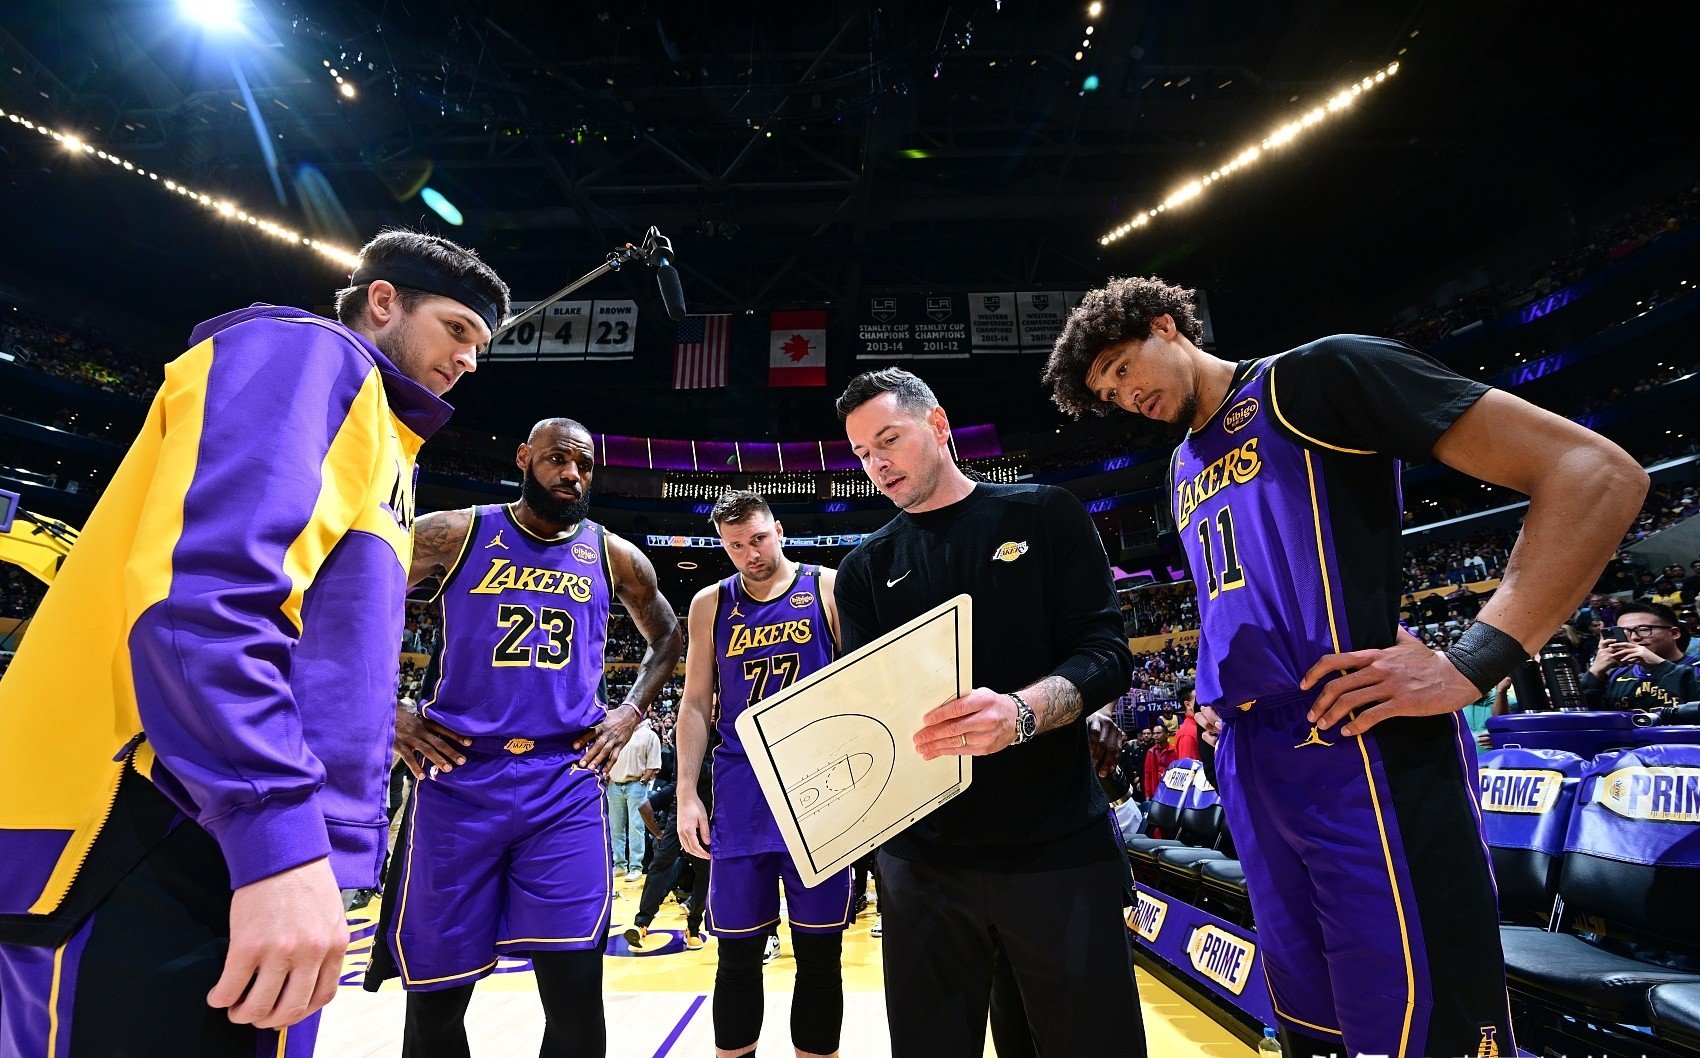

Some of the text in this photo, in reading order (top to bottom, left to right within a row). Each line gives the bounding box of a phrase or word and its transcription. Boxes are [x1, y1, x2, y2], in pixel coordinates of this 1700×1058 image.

[553, 307, 581, 315] BLAKE
[599, 307, 631, 315] BROWN
[554, 321, 573, 345] 4
[595, 320, 630, 345] 23
[860, 332, 909, 340] CHAMPIONS
[915, 331, 965, 339] CHAMPIONS
[866, 342, 904, 351] 2013-14
[923, 341, 959, 351] 2011-12
[1226, 404, 1257, 426] bibigo
[1177, 437, 1262, 534] LAKERS
[1199, 504, 1246, 601] 11
[469, 558, 593, 603] LAKERS
[491, 603, 575, 670] 23
[725, 618, 812, 658] LAKERS
[743, 652, 800, 703] 77
[1480, 774, 1546, 806] PRIME
[1199, 932, 1246, 984] PRIME
